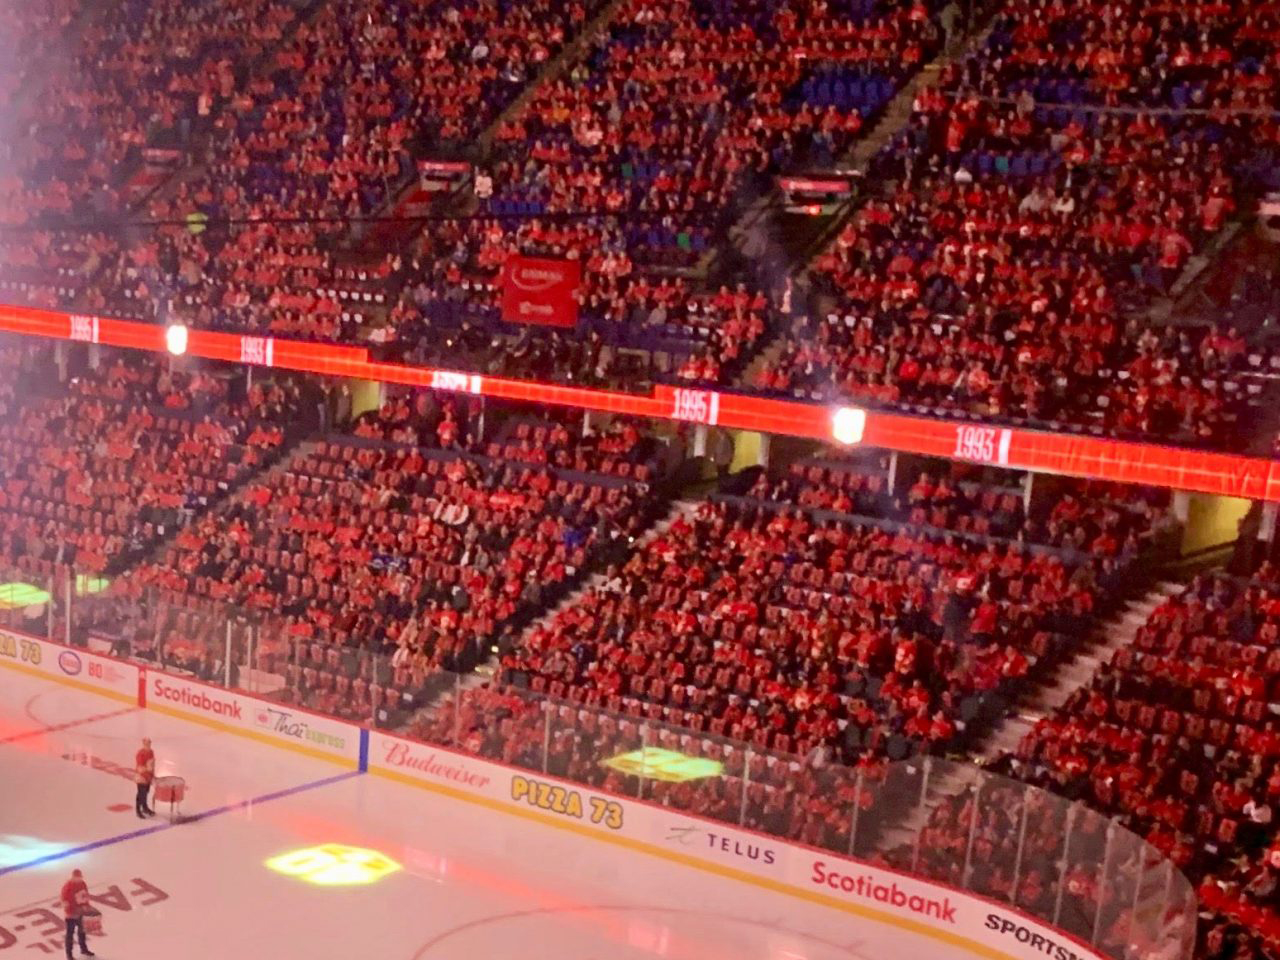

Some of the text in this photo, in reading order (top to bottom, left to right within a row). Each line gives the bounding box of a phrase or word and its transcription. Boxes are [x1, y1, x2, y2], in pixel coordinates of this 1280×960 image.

[672, 388, 707, 422] 1995
[953, 426, 996, 461] 1993
[20, 641, 43, 665] 73
[154, 678, 243, 721] Scotiabank
[382, 738, 491, 790] Budweiser
[510, 775, 625, 831] PIZZA 73
[707, 833, 777, 866] TELUS
[811, 861, 958, 925] Scotiabank
